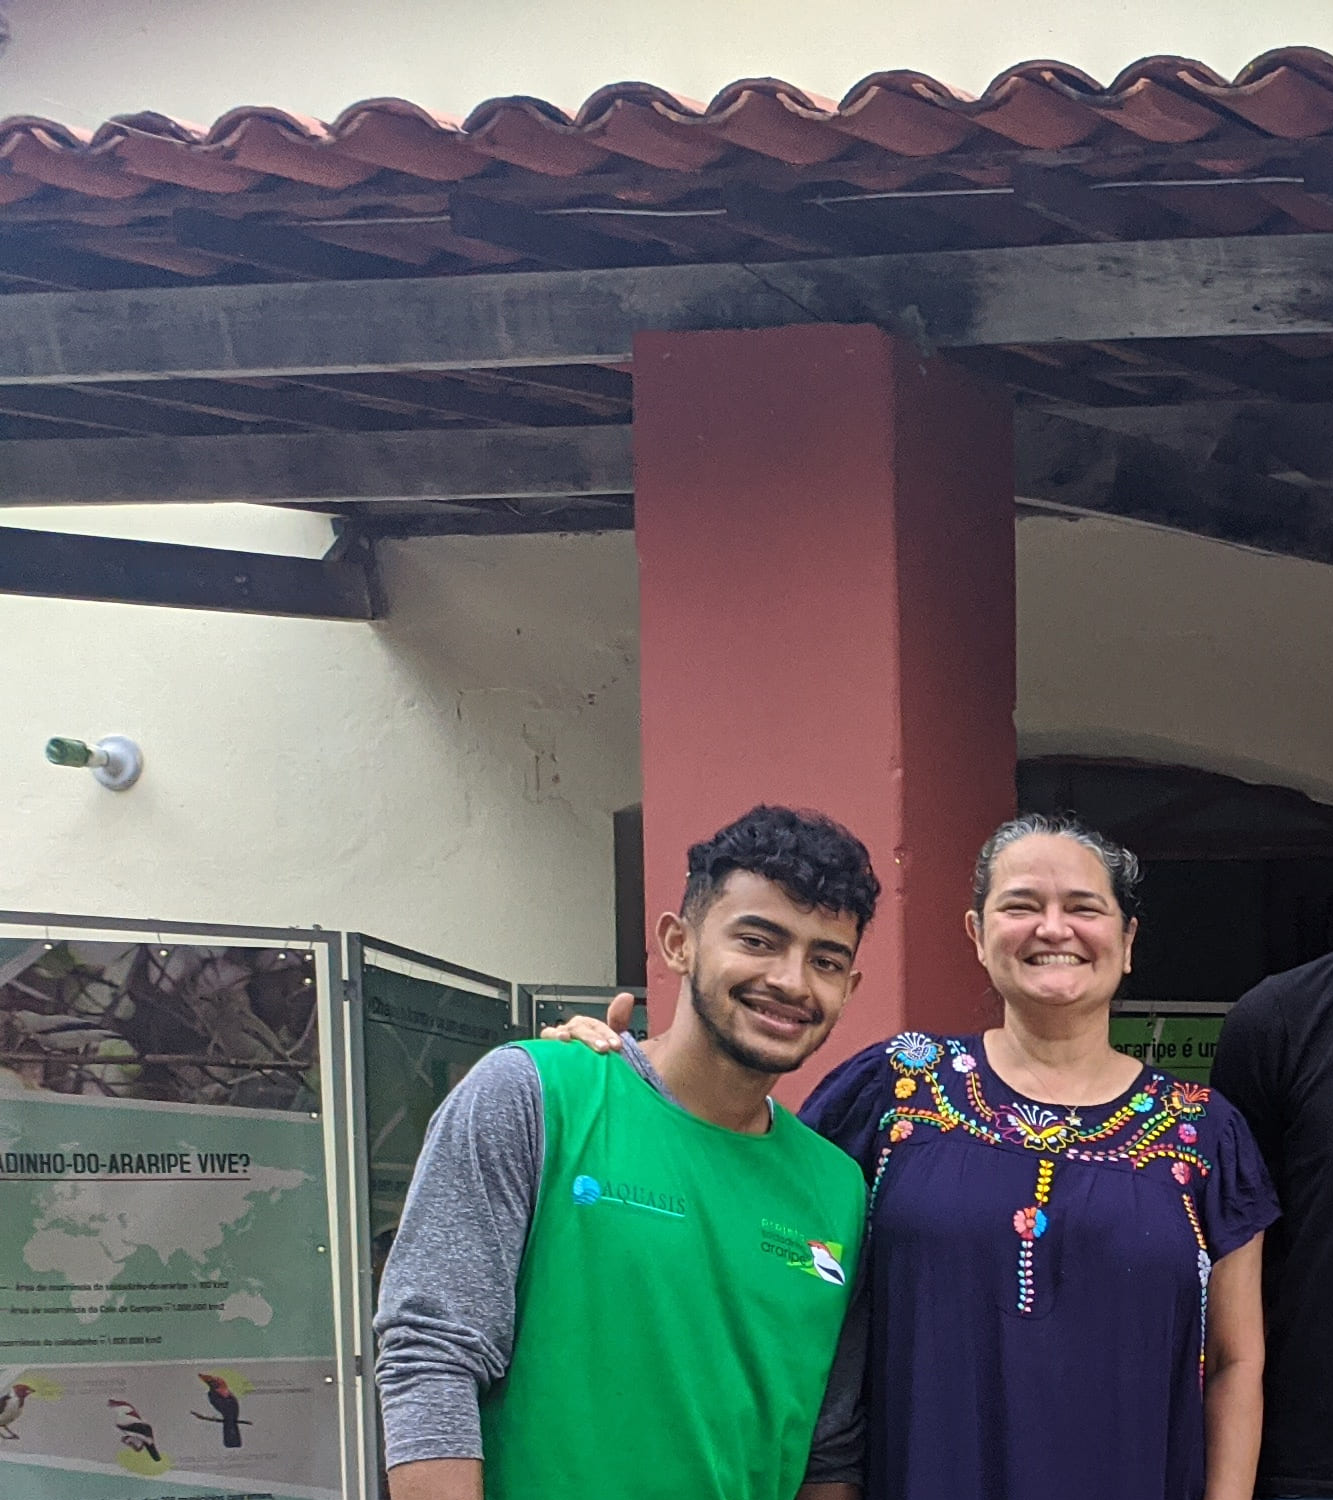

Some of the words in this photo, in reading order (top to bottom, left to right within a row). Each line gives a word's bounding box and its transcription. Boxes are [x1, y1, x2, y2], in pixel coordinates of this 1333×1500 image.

[1182, 1037, 1192, 1057] é
[197, 1152, 250, 1174] VIVE?
[602, 1180, 686, 1215] AQUASIS
